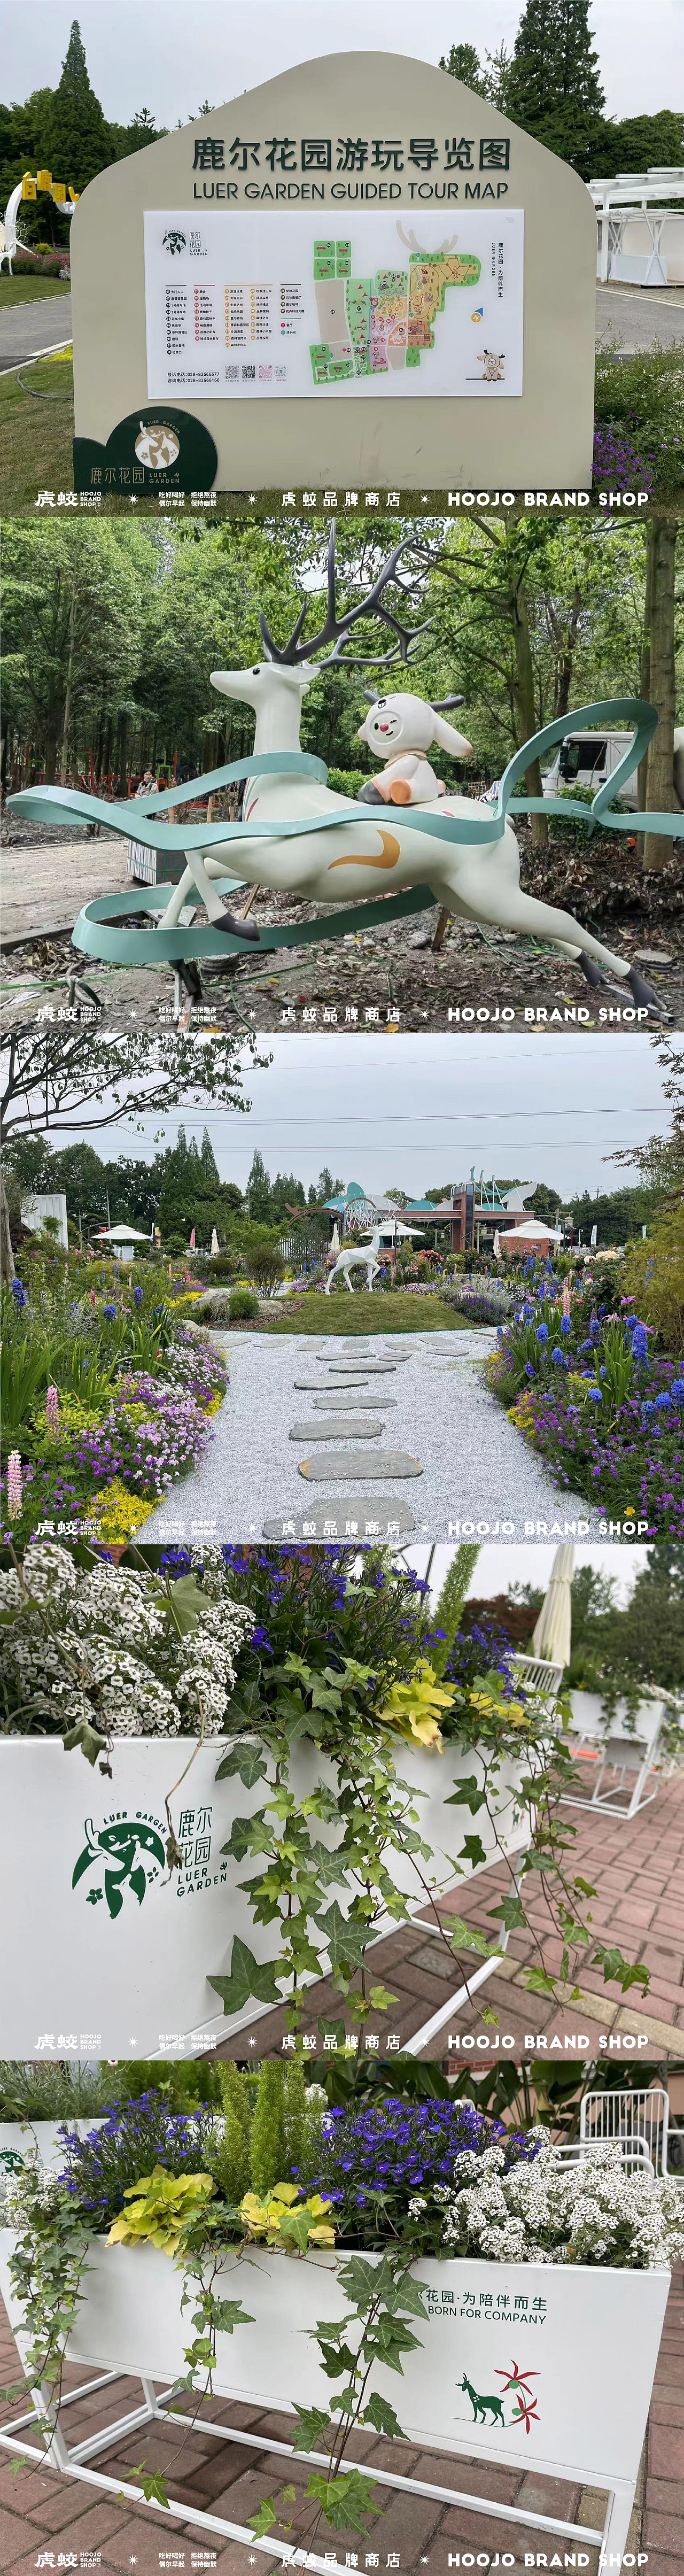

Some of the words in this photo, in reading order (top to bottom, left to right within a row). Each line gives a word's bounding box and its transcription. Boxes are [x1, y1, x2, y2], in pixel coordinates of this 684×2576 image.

[192, 137, 510, 171] 鹿尔花园游玩导览图
[193, 183, 238, 198] LUER
[244, 183, 324, 198] GARDEN
[330, 183, 402, 198] GUIDED
[408, 183, 458, 198] TOUR
[465, 183, 509, 198] MAP
[91, 467, 144, 484] 鹿尔花园
[103, 1811, 128, 1825] LUER
[135, 1811, 167, 1834] GARGEN
[178, 1807, 212, 1839] 鹿尔
[179, 1836, 211, 1869] 花园
[176, 1873, 227, 1897] GARDEN
[178, 1867, 208, 1885] LUER
[418, 2289, 548, 2311] 花园·为陪伴而生
[428, 2306, 457, 2316] BORN
[460, 2308, 481, 2318] FOR
[484, 2311, 546, 2324] COMPANY
